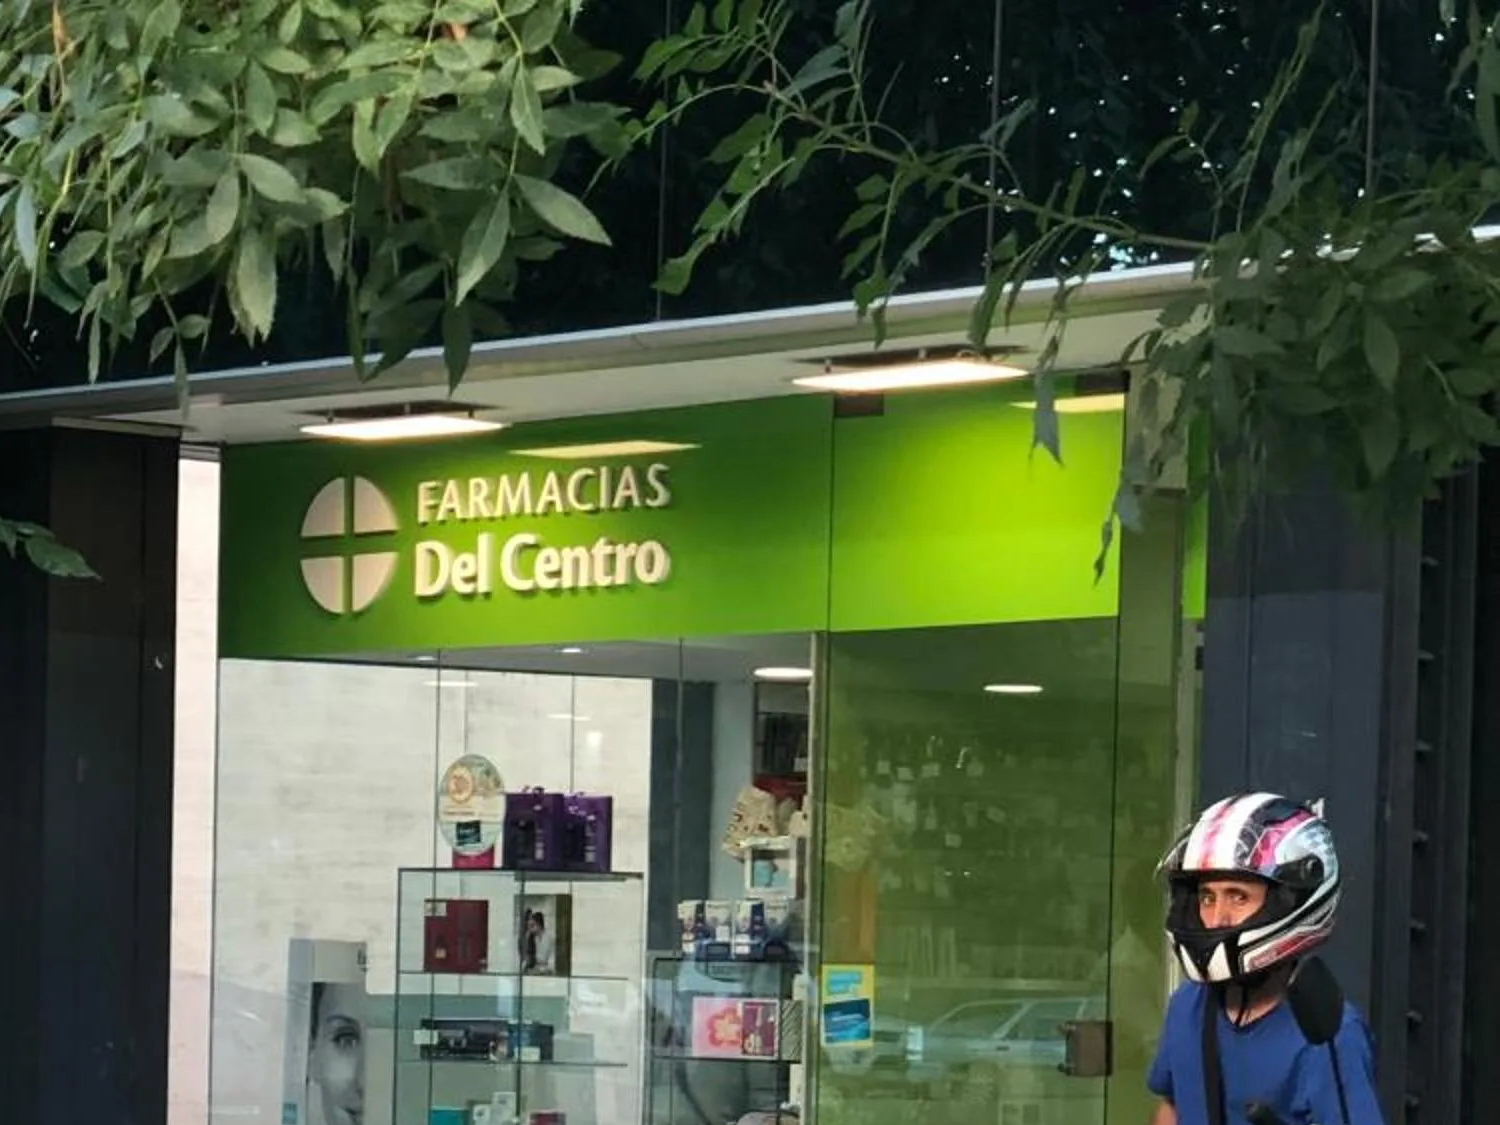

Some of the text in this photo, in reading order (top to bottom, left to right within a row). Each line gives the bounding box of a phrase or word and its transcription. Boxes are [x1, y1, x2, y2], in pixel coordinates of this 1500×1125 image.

[417, 463, 671, 524] FARMACIAS
[415, 532, 671, 597] Del Centro
